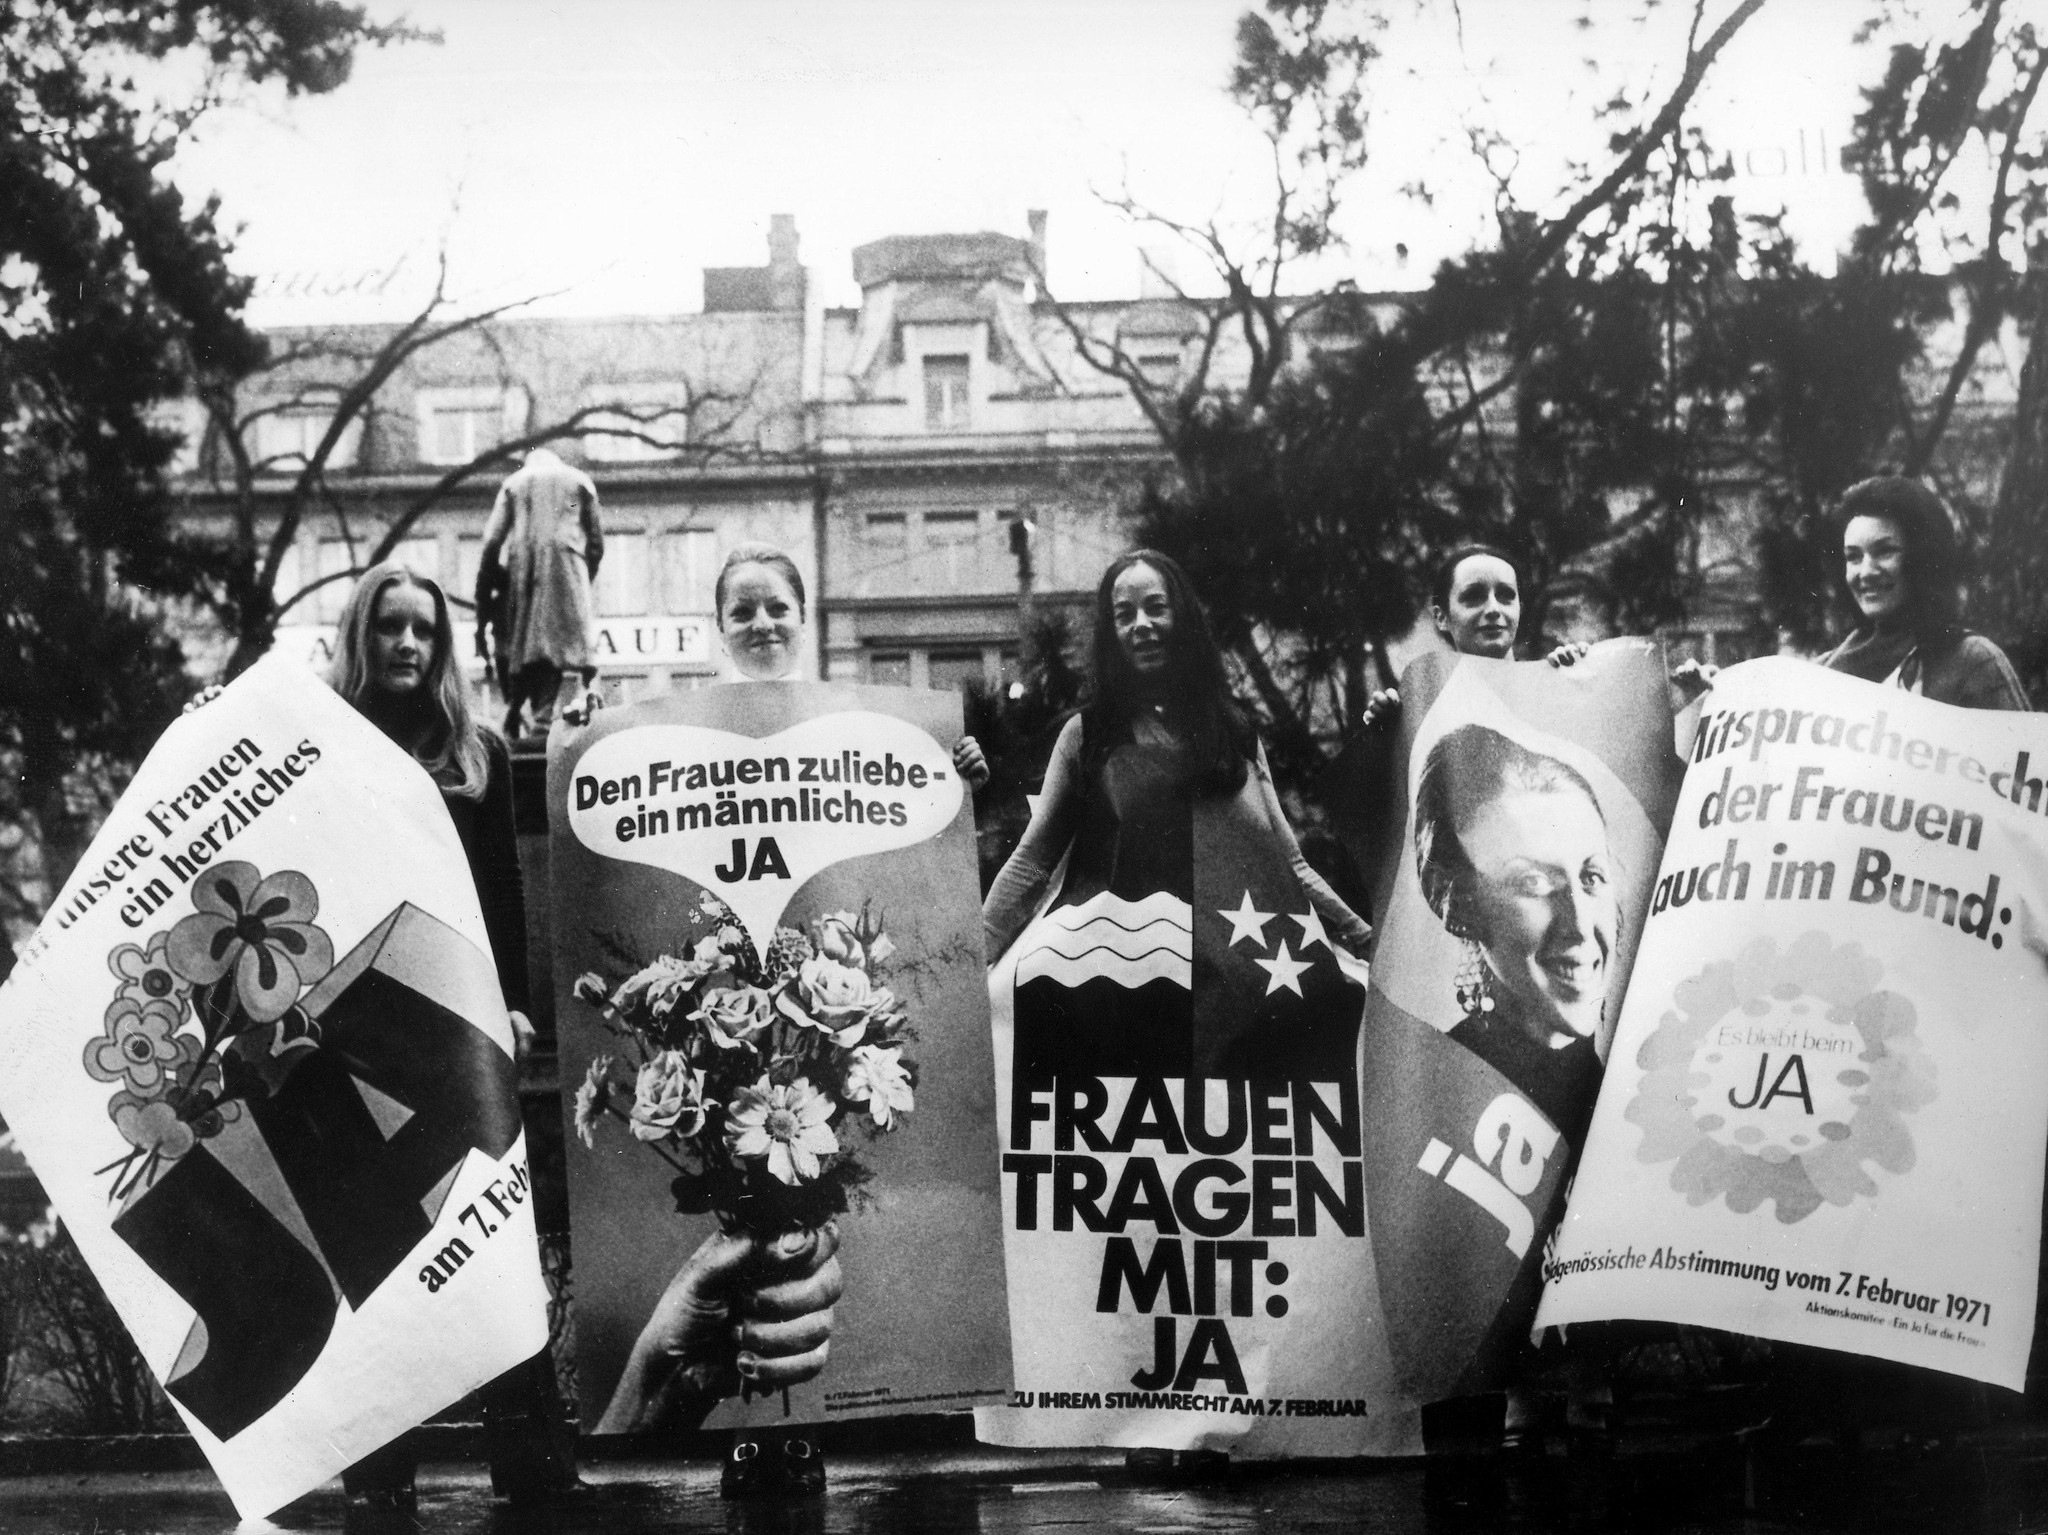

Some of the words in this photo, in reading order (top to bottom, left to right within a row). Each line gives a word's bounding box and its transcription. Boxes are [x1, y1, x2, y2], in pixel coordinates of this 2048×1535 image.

[576, 774, 641, 810] Den
[649, 753, 790, 796] Frauen
[1693, 706, 2048, 817] itspracherech
[57, 828, 154, 929] unsere
[144, 735, 263, 840] Frauen
[119, 873, 174, 929] ein
[167, 735, 322, 878] herzliches
[615, 804, 669, 842] ein
[676, 788, 908, 831] männliches
[1699, 766, 1783, 829] der
[1788, 766, 1984, 851] Frauen
[714, 837, 791, 883] JA
[1652, 839, 1751, 917] auch
[1765, 842, 1836, 901] im
[1849, 846, 2012, 950] Bund:
[1718, 1026, 1743, 1047] Es
[1746, 1027, 1797, 1048] bleibt
[1802, 1029, 1854, 1053] beim
[1010, 1075, 1361, 1157] FRAUEN
[1728, 1052, 1814, 1115] JA
[112, 900, 524, 1442] JA
[479, 1155, 529, 1221] Feb
[1002, 1153, 1365, 1237] TRAGEN
[1417, 1093, 1561, 1260] ja
[460, 1203, 500, 1248] 7.
[417, 1238, 474, 1293] am
[1096, 1237, 1289, 1318] MIT:
[1649, 1247, 1781, 1291] Abstimmung
[1785, 1270, 1831, 1294] vom
[1835, 1271, 1850, 1298] 7.
[1856, 1275, 1940, 1315] Februar
[1946, 1292, 1991, 1327] 1971
[1805, 1301, 1885, 1326] Aktionskomitee
[1130, 1316, 1249, 1395] JA
[1039, 1392, 1101, 1410] IHREM
[1105, 1392, 1228, 1412] STIMMRECHT
[1230, 1397, 1265, 1415] AM
[1268, 1399, 1282, 1416] 7.
[1284, 1399, 1367, 1418] FEBRUAR
